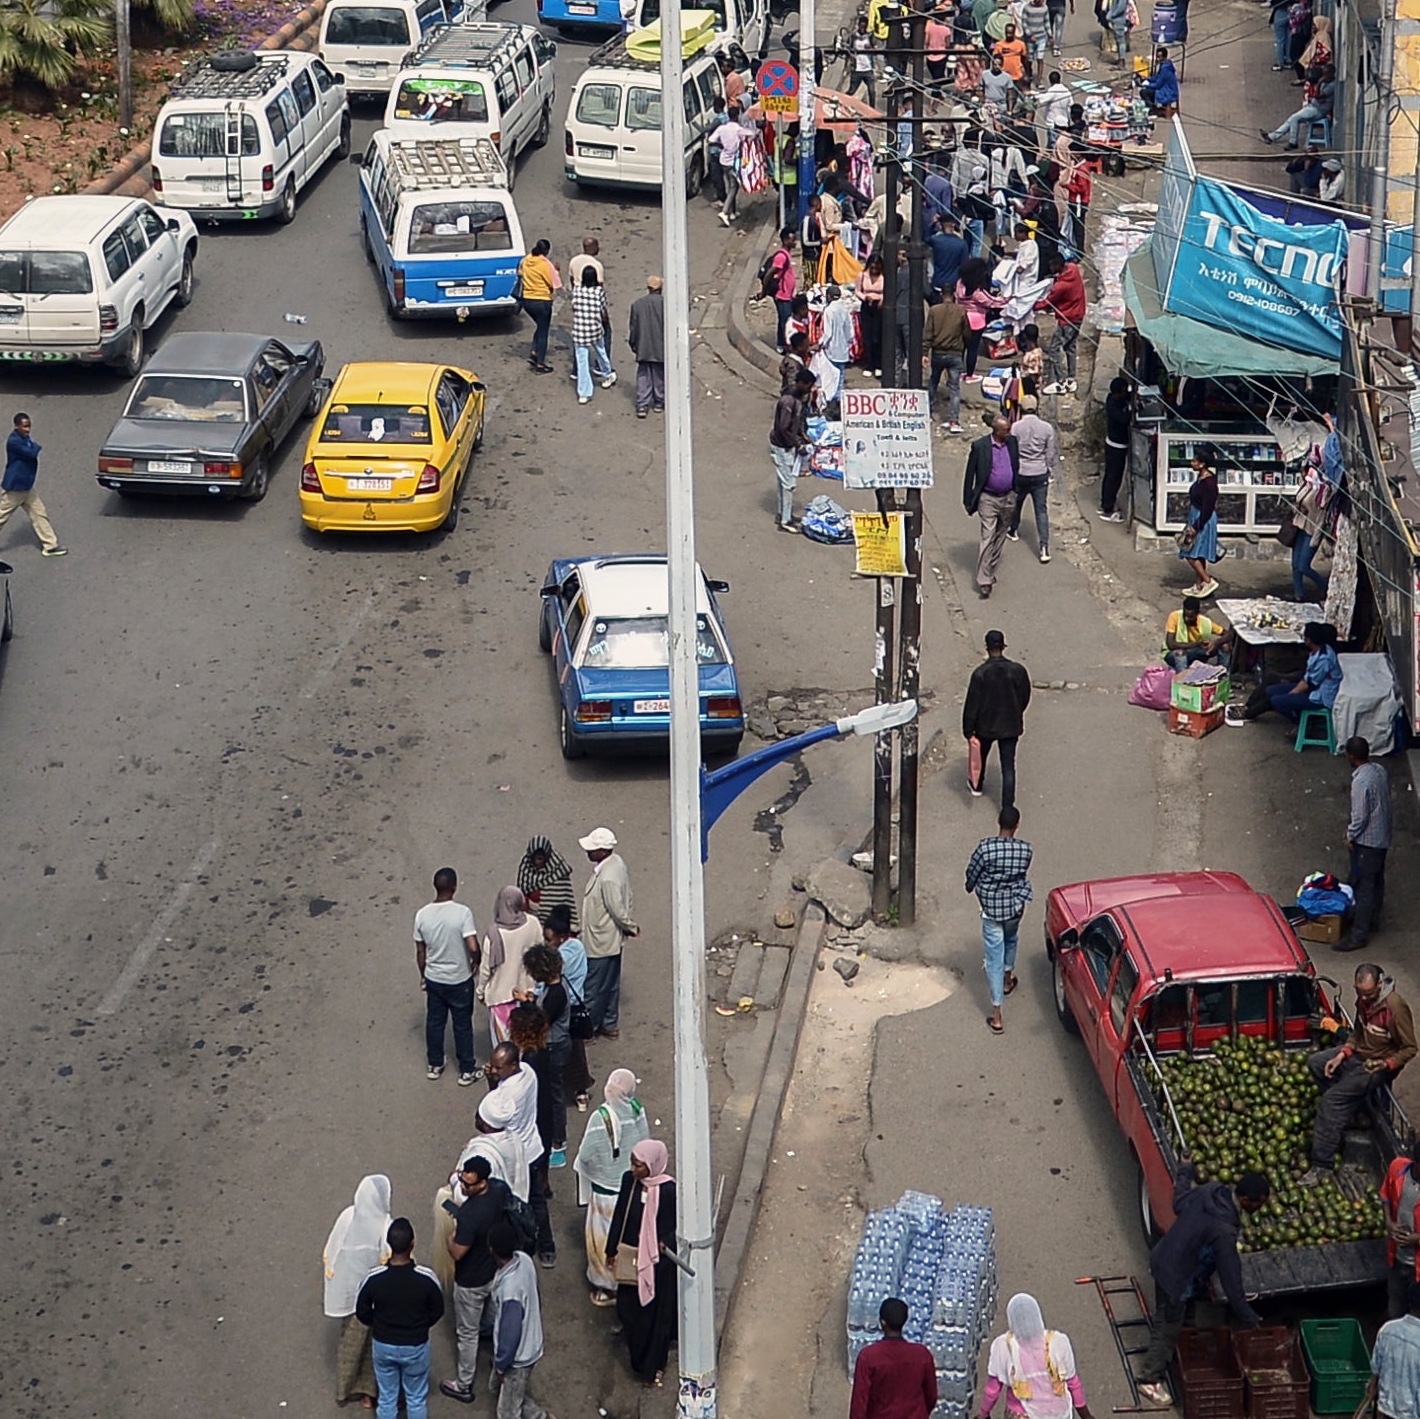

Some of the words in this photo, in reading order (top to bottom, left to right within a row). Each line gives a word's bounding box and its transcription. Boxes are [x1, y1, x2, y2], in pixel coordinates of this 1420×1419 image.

[845, 394, 886, 416] BBC
[903, 420, 926, 431] English
[643, 700, 669, 711] 1-264
